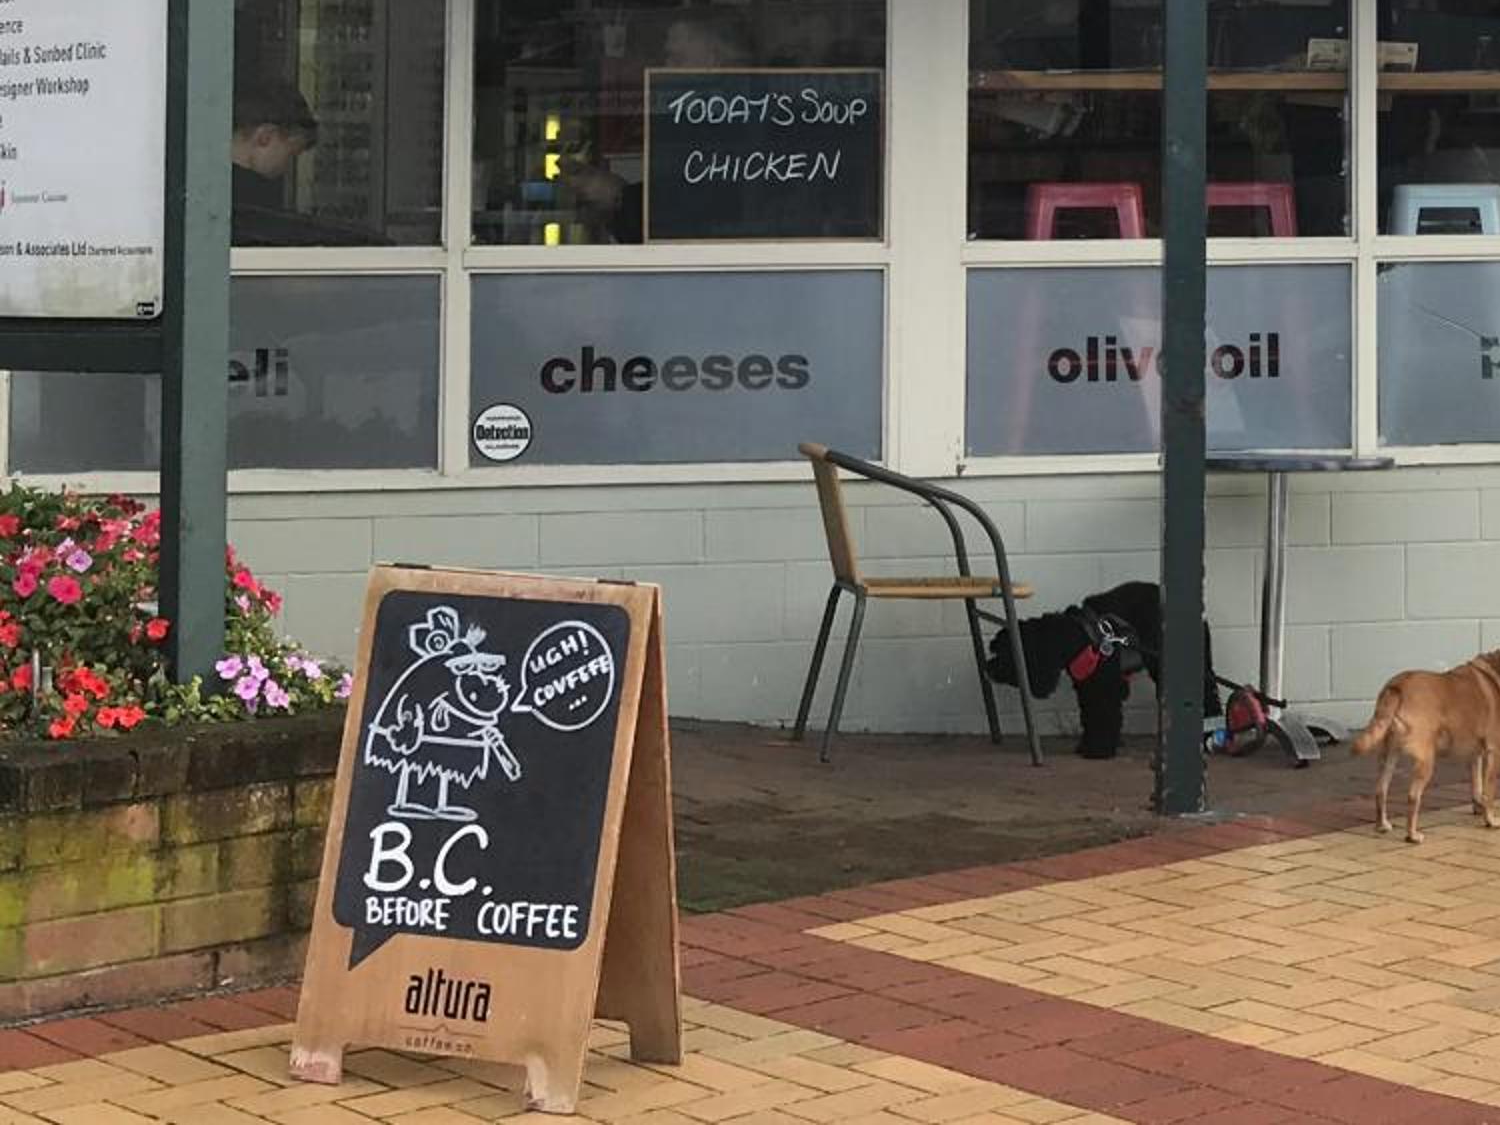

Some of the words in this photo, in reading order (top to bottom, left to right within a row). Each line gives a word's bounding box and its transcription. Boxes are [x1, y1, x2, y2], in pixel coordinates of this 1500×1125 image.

[23, 46, 31, 65] &
[33, 43, 74, 64] Sunbed
[75, 41, 107, 61] Clinic
[35, 77, 90, 97] Workshop
[668, 90, 795, 126] TODAY'S
[683, 148, 841, 184] CHICKEN
[16, 241, 23, 256] &
[25, 242, 70, 257] Associates
[71, 241, 87, 256] Ltd
[539, 346, 811, 394] cheeses
[1211, 332, 1280, 379] oil
[529, 630, 589, 674] UGH!
[362, 820, 493, 896] B.C.
[365, 895, 451, 930] BEFORE
[476, 901, 579, 939] COFFEE
[405, 966, 492, 1023] altura
